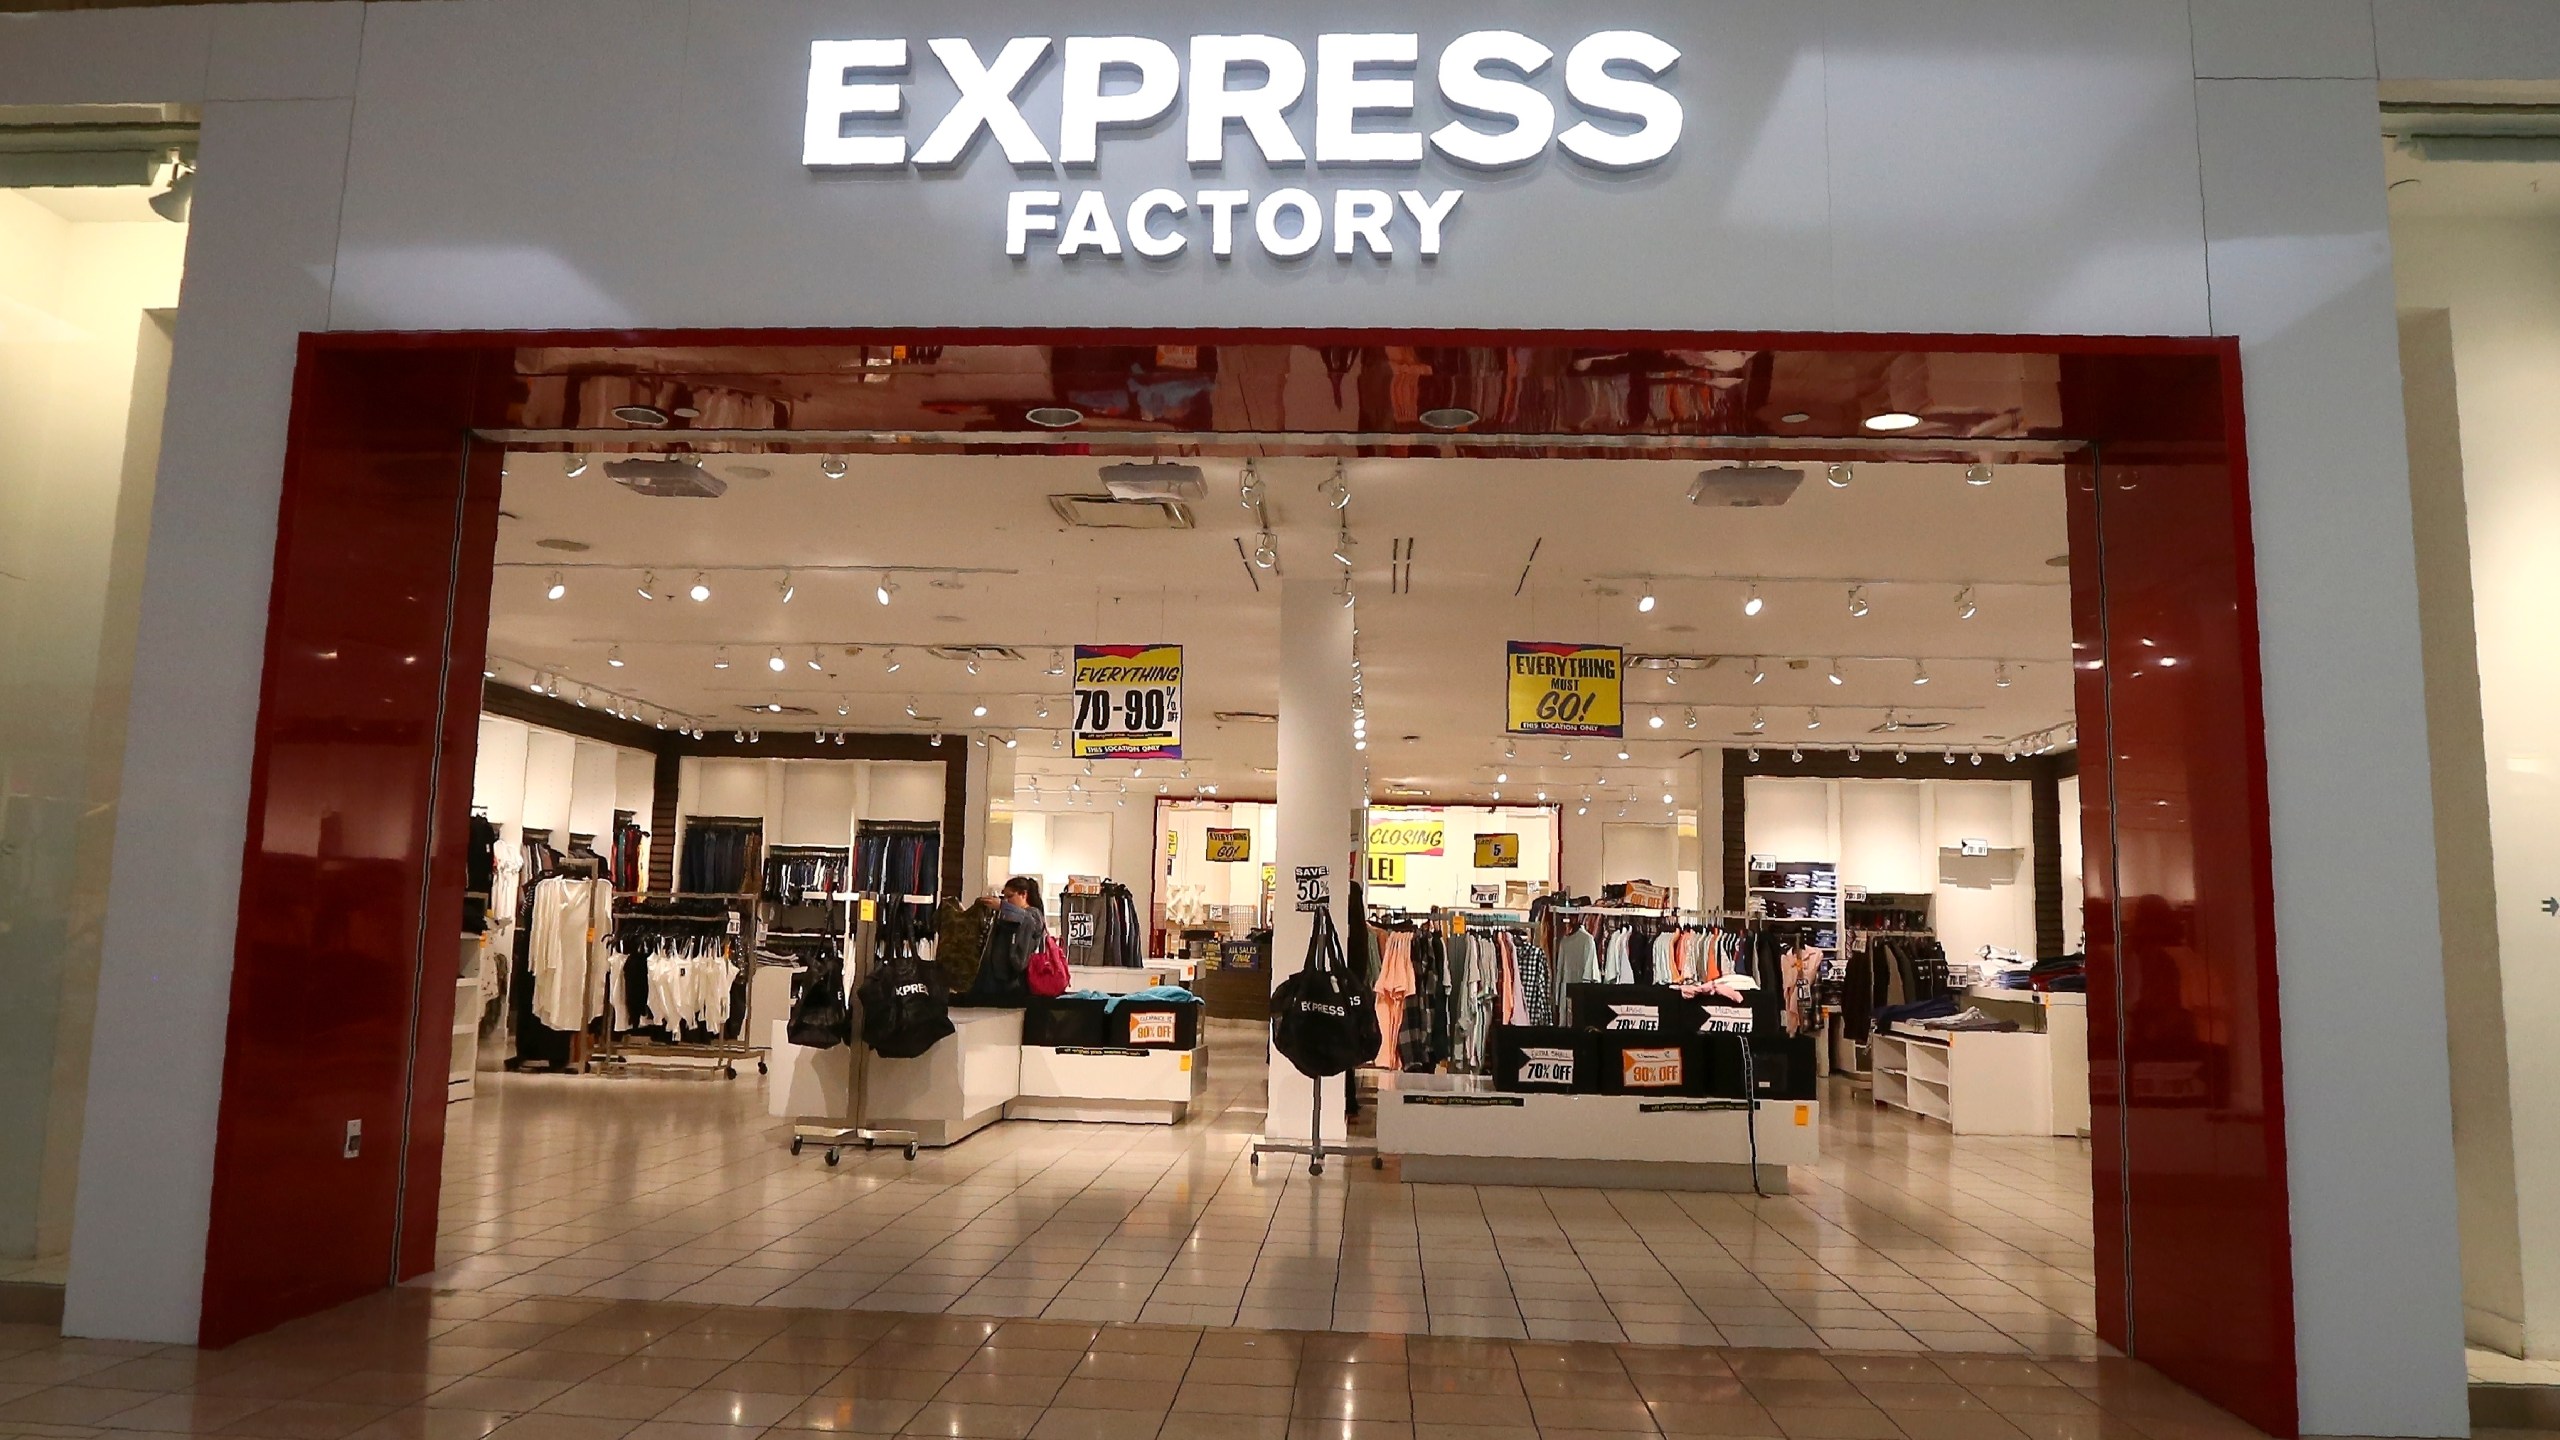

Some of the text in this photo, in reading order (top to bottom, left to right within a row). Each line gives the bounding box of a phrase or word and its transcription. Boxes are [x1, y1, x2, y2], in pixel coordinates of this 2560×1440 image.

[801, 29, 1684, 169] EXPRESS
[1006, 188, 1464, 260] FACTORY
[1076, 666, 1180, 682] EVERYTHING
[1516, 655, 1616, 679] EVERYTHING
[1551, 678, 1579, 691] MUST
[1536, 691, 1596, 722] GO!
[1541, 722, 1578, 731] LOCATION
[1104, 745, 1140, 753] LOCATION
[1370, 828, 1443, 847] CLOSING
[1217, 845, 1241, 858] GO!
[1493, 843, 1502, 857] 5
[1296, 867, 1330, 876] SAVE!
[1368, 857, 1394, 882] LE!
[1296, 879, 1330, 901] 50%
[1239, 946, 1257, 954] SALES
[895, 983, 929, 996] XPRE
[1157, 1025, 1172, 1038] OFF
[1616, 1019, 1637, 1030] 70%
[1709, 1020, 1730, 1031] 70%
[1527, 1063, 1572, 1081] 70% OFF
[1633, 1065, 1678, 1081] 90% OFF
